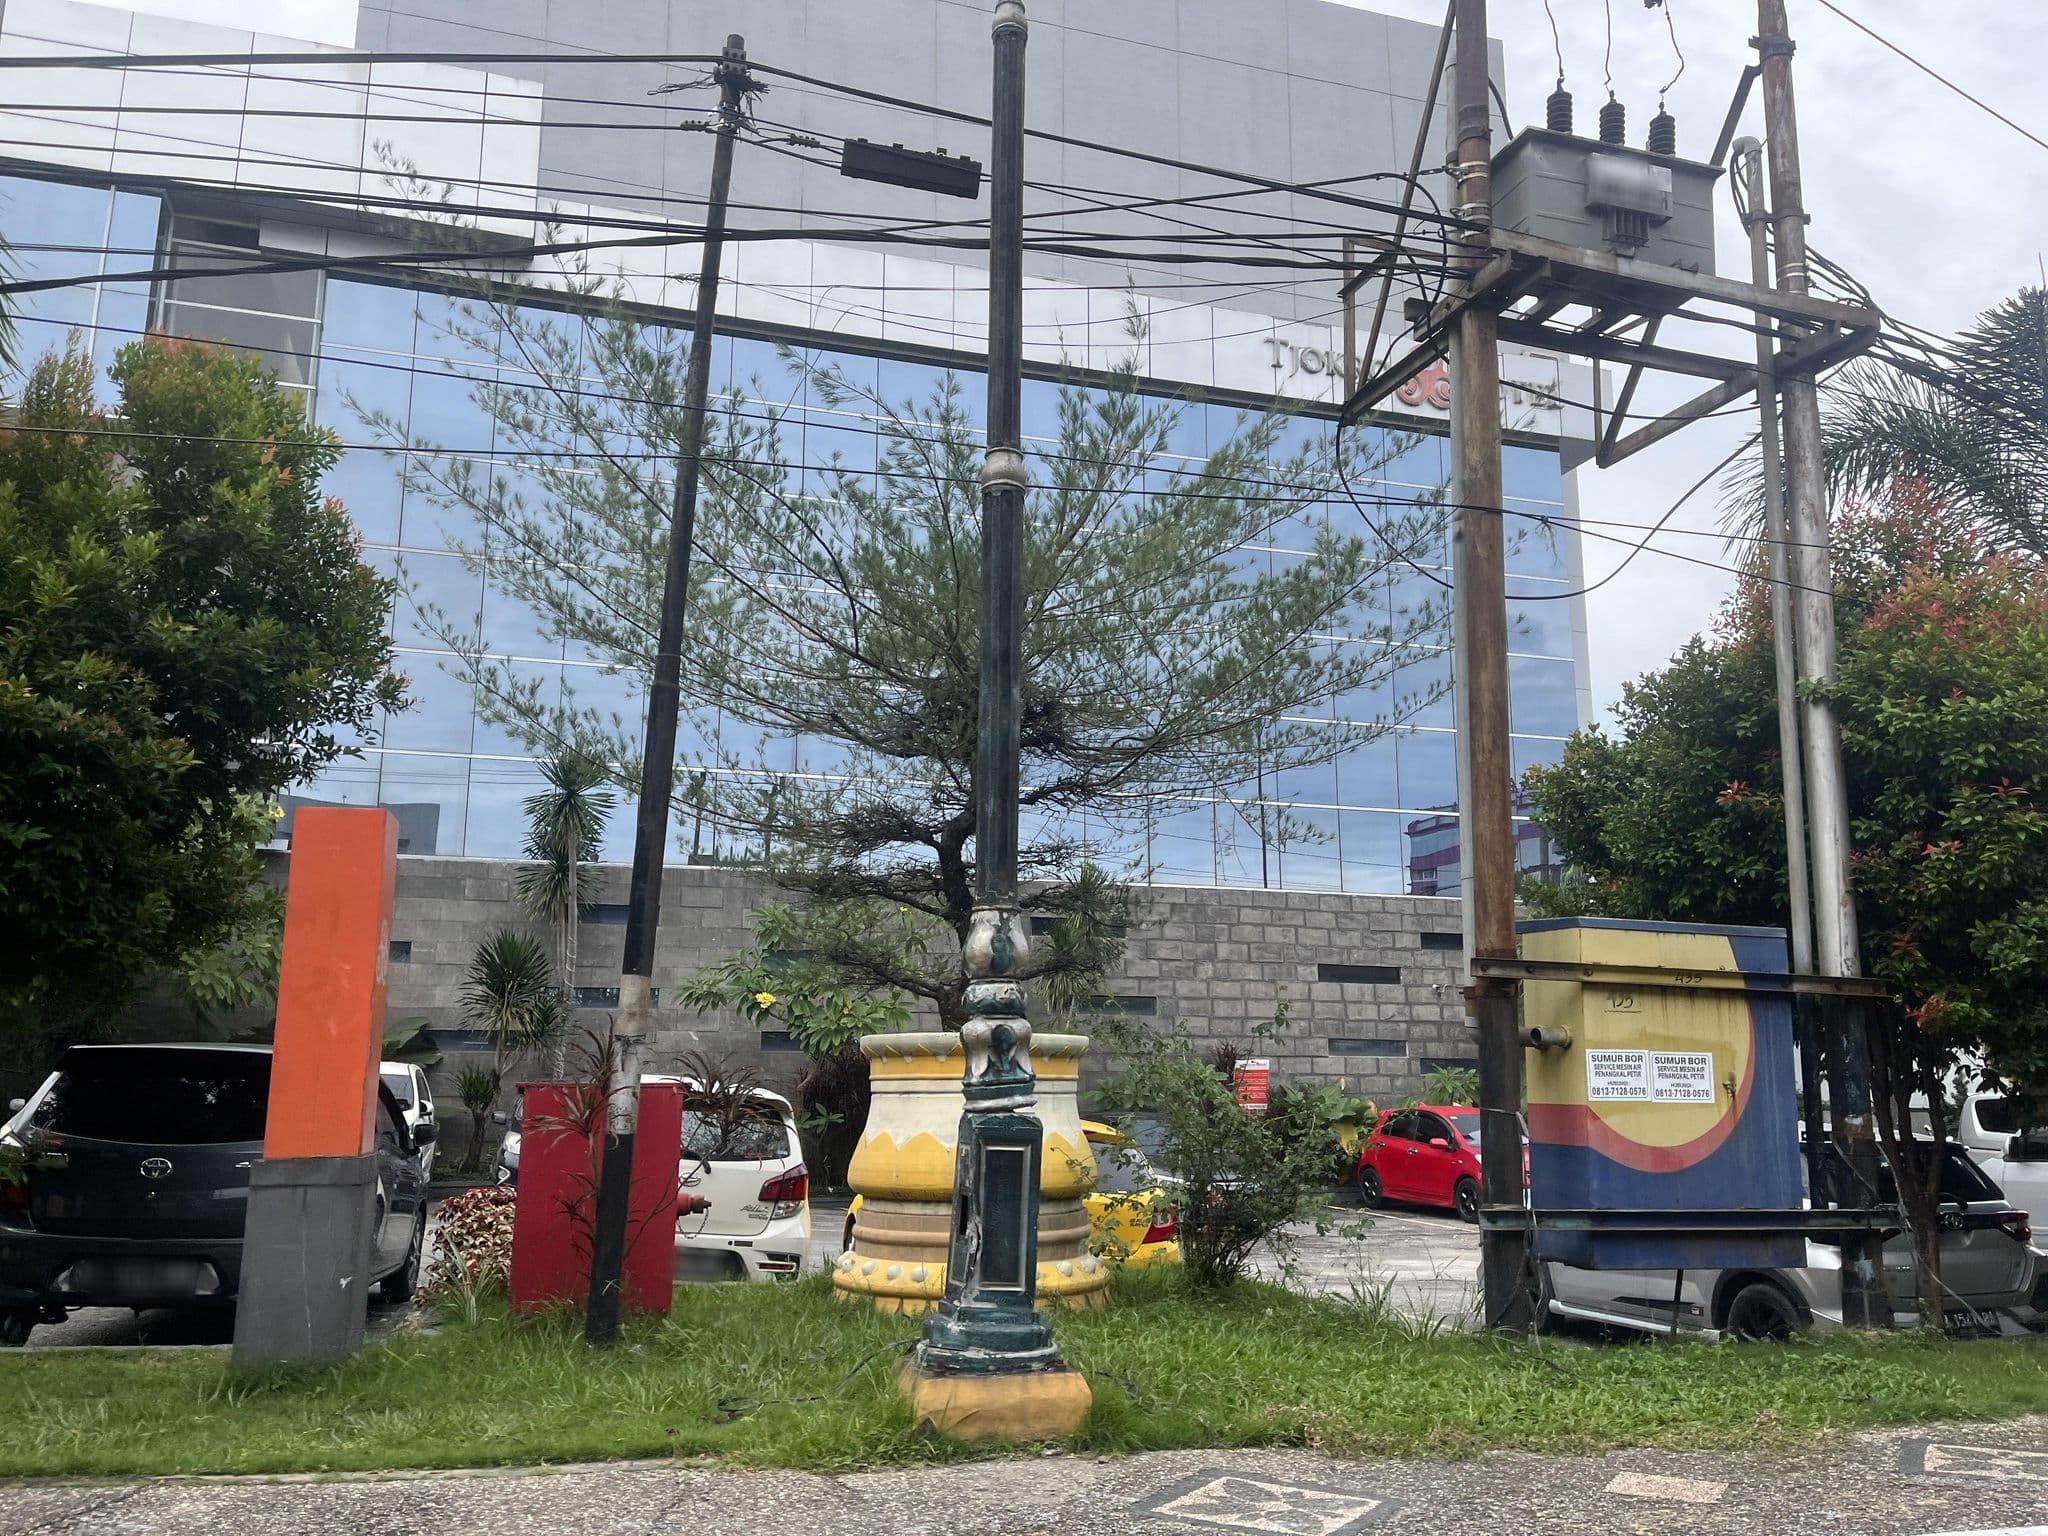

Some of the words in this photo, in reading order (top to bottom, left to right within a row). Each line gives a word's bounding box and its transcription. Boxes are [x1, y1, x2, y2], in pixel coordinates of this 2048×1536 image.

[1591, 1054, 1624, 1063] SUMUR
[1624, 1054, 1643, 1063] BOR
[1654, 1056, 1687, 1065] SUMUR
[1688, 1057, 1707, 1065] BOR
[1593, 1063, 1615, 1071] SERVICE
[1657, 1065, 1679, 1073] SERVICE
[1594, 1070, 1626, 1078] PENANGKAL
[1627, 1070, 1642, 1078] PETIR
[1658, 1072, 1689, 1080] PENANGKAL
[1591, 1087, 1647, 1096] 0813-7128-0576
[1655, 1088, 1710, 1098] 0813-7128-0576
